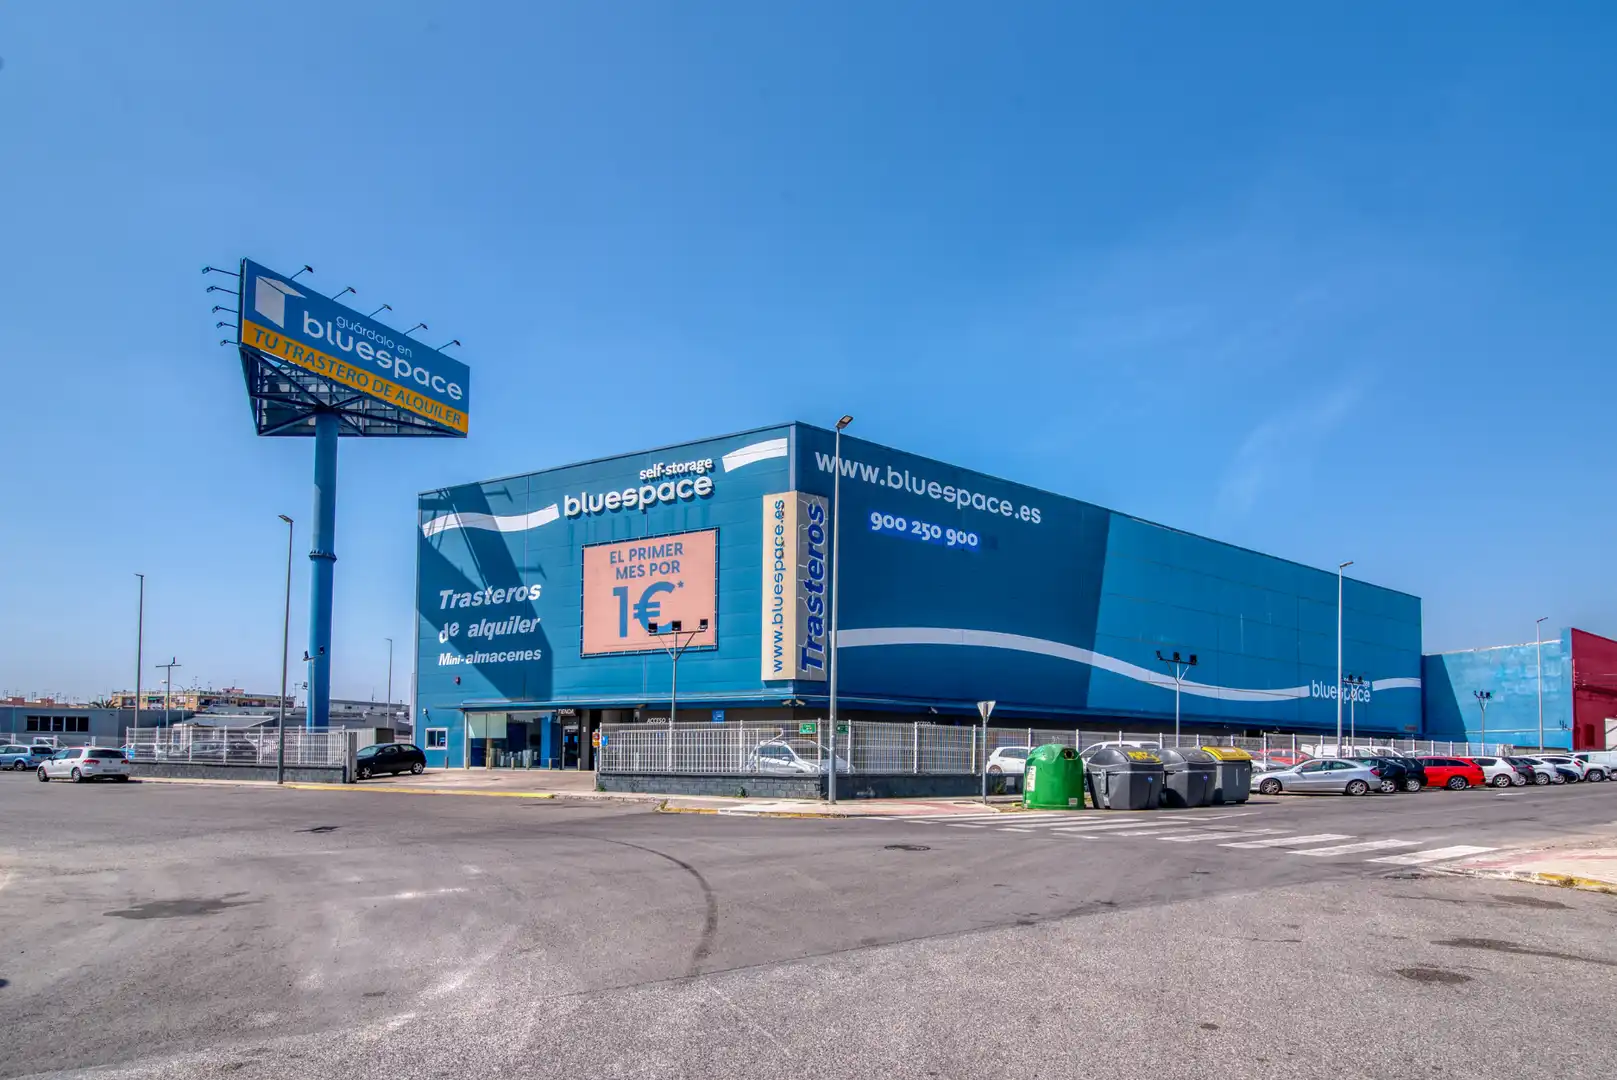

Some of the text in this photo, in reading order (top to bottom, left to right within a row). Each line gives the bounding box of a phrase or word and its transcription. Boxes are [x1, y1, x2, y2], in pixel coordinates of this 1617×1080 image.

[303, 310, 463, 400] bluespace
[336, 316, 412, 358] guárdalo en
[253, 327, 461, 426] TU TRASTERO DE ALQUILER
[639, 458, 713, 480] self-storage
[815, 451, 1042, 524] www.bluespace.es
[564, 476, 713, 516] bluespace
[870, 511, 978, 547] 900 250 900
[610, 542, 684, 564] EL PRIMER
[616, 560, 680, 580] MES POR
[440, 584, 542, 610] Trasteros
[771, 499, 786, 673] www.bluespace.es
[801, 502, 826, 672] Trasteros
[439, 616, 540, 643] de alquiler
